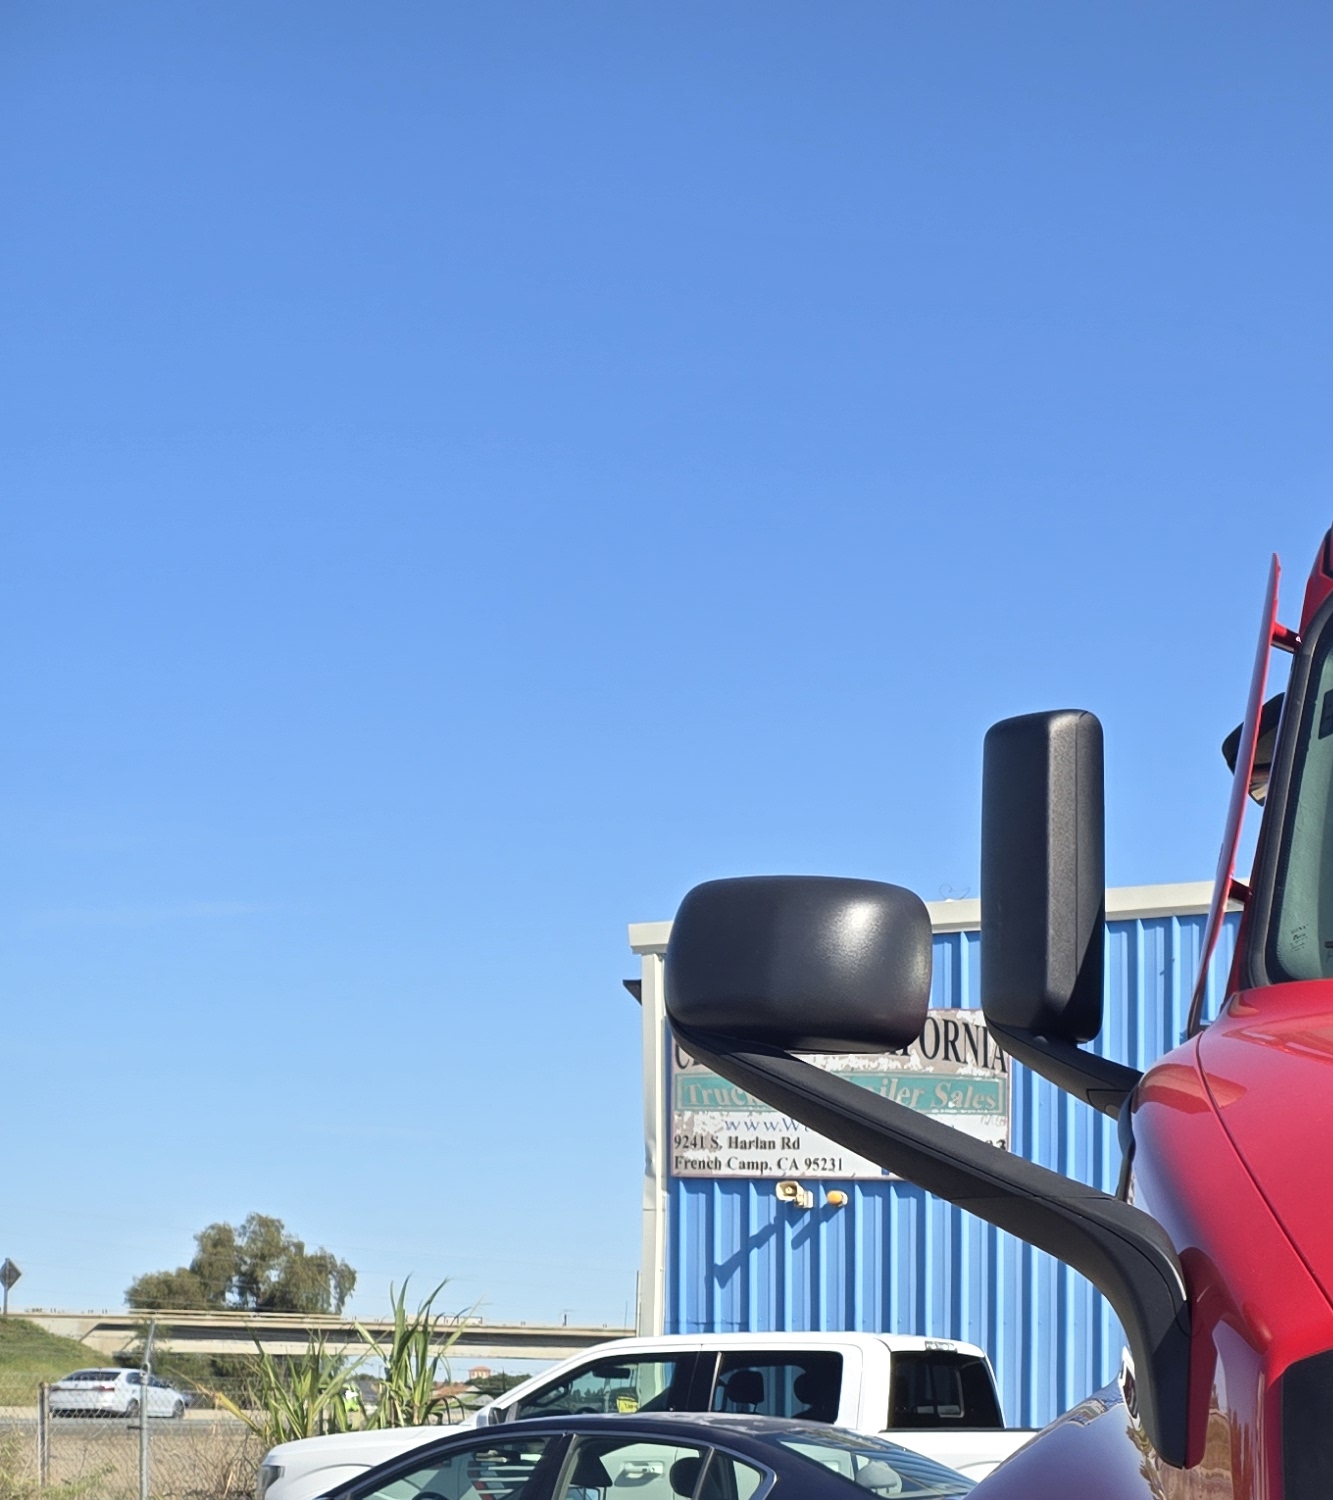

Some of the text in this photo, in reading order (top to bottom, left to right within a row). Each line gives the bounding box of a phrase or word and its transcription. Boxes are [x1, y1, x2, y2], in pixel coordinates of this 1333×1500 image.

[895, 1017, 1007, 1073] ORNIA
[931, 1081, 995, 1109] Sales
[674, 1135, 704, 1150] 9241
[728, 1136, 776, 1150] Harlan
[781, 1136, 801, 1150] Rd
[674, 1156, 843, 1175] French Camp, CA 95231
